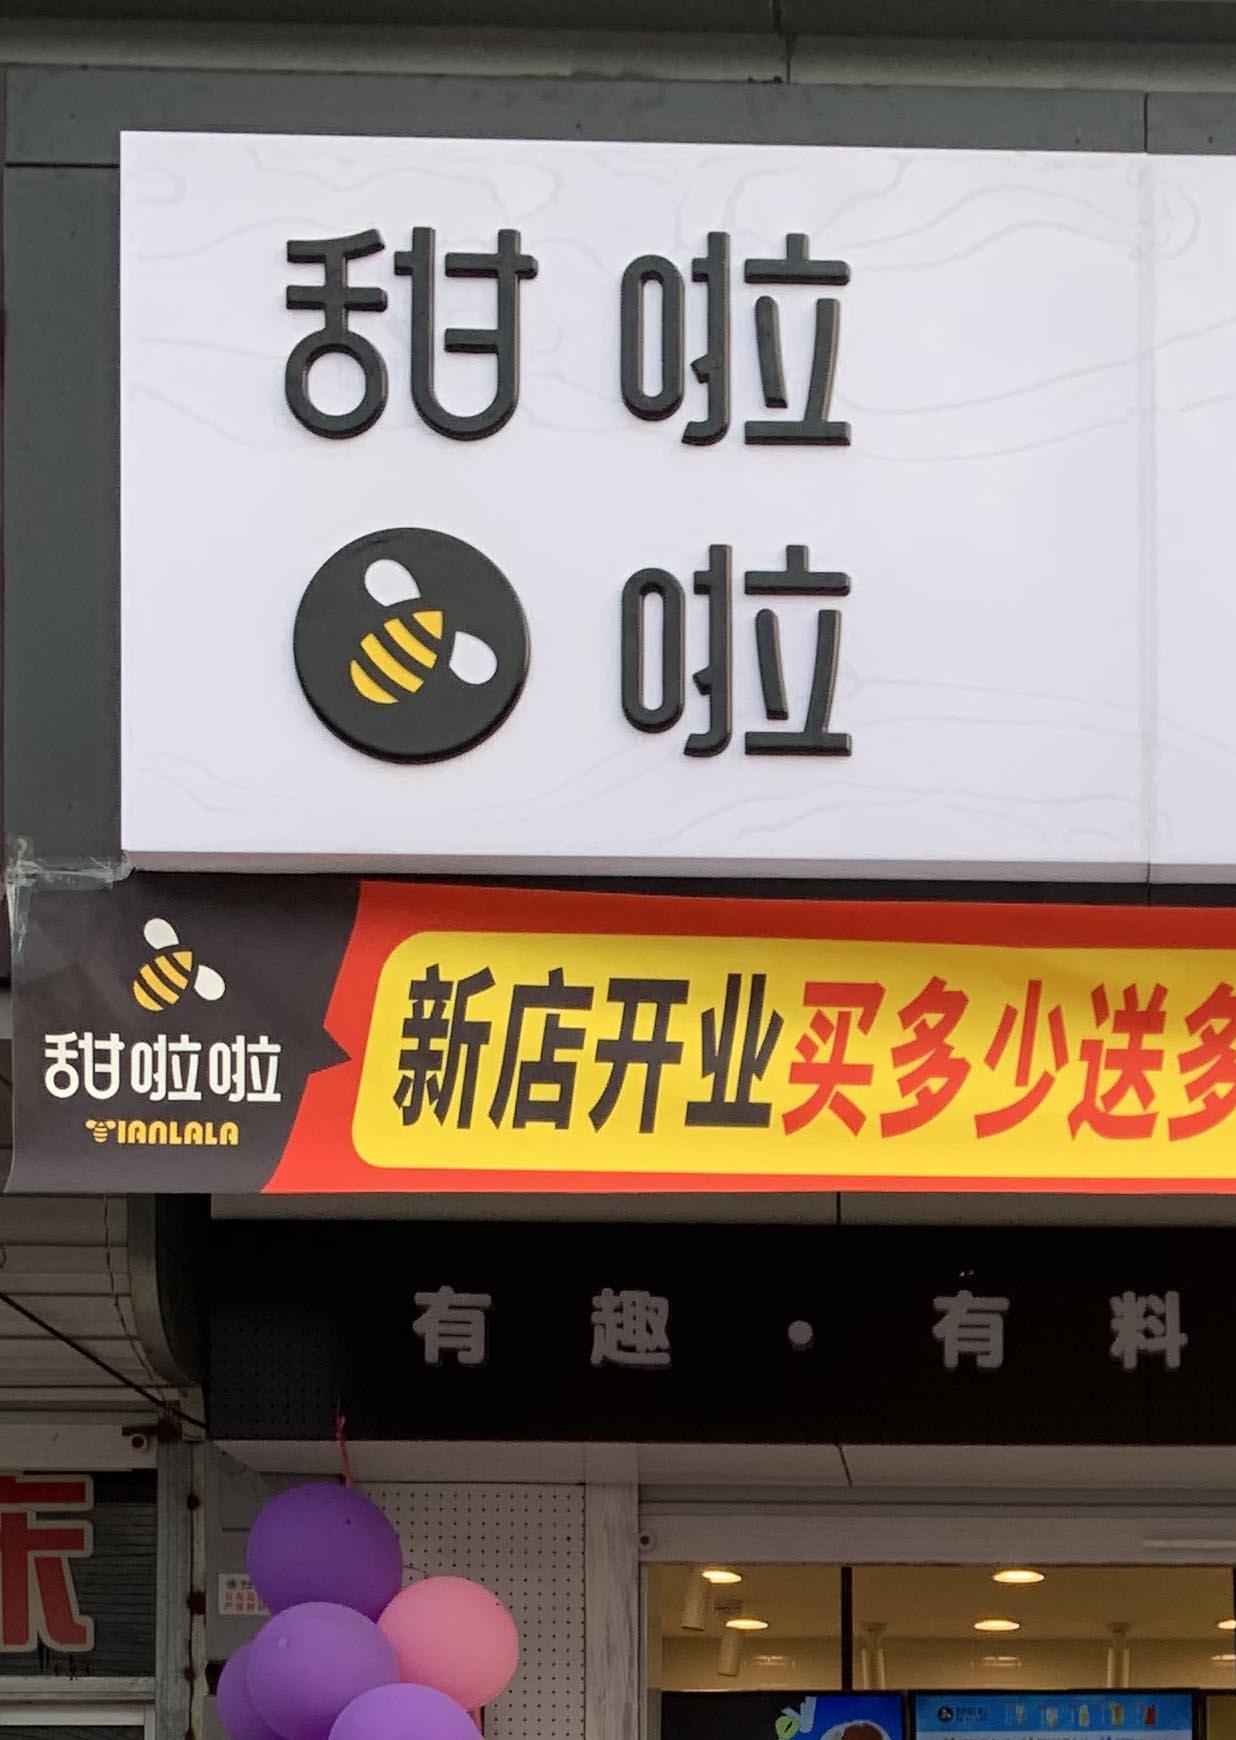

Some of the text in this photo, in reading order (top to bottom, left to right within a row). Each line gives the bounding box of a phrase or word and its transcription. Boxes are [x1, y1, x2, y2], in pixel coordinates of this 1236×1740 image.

[620, 543, 853, 759] 啦
[43, 1029, 283, 1105] 甜啦啦
